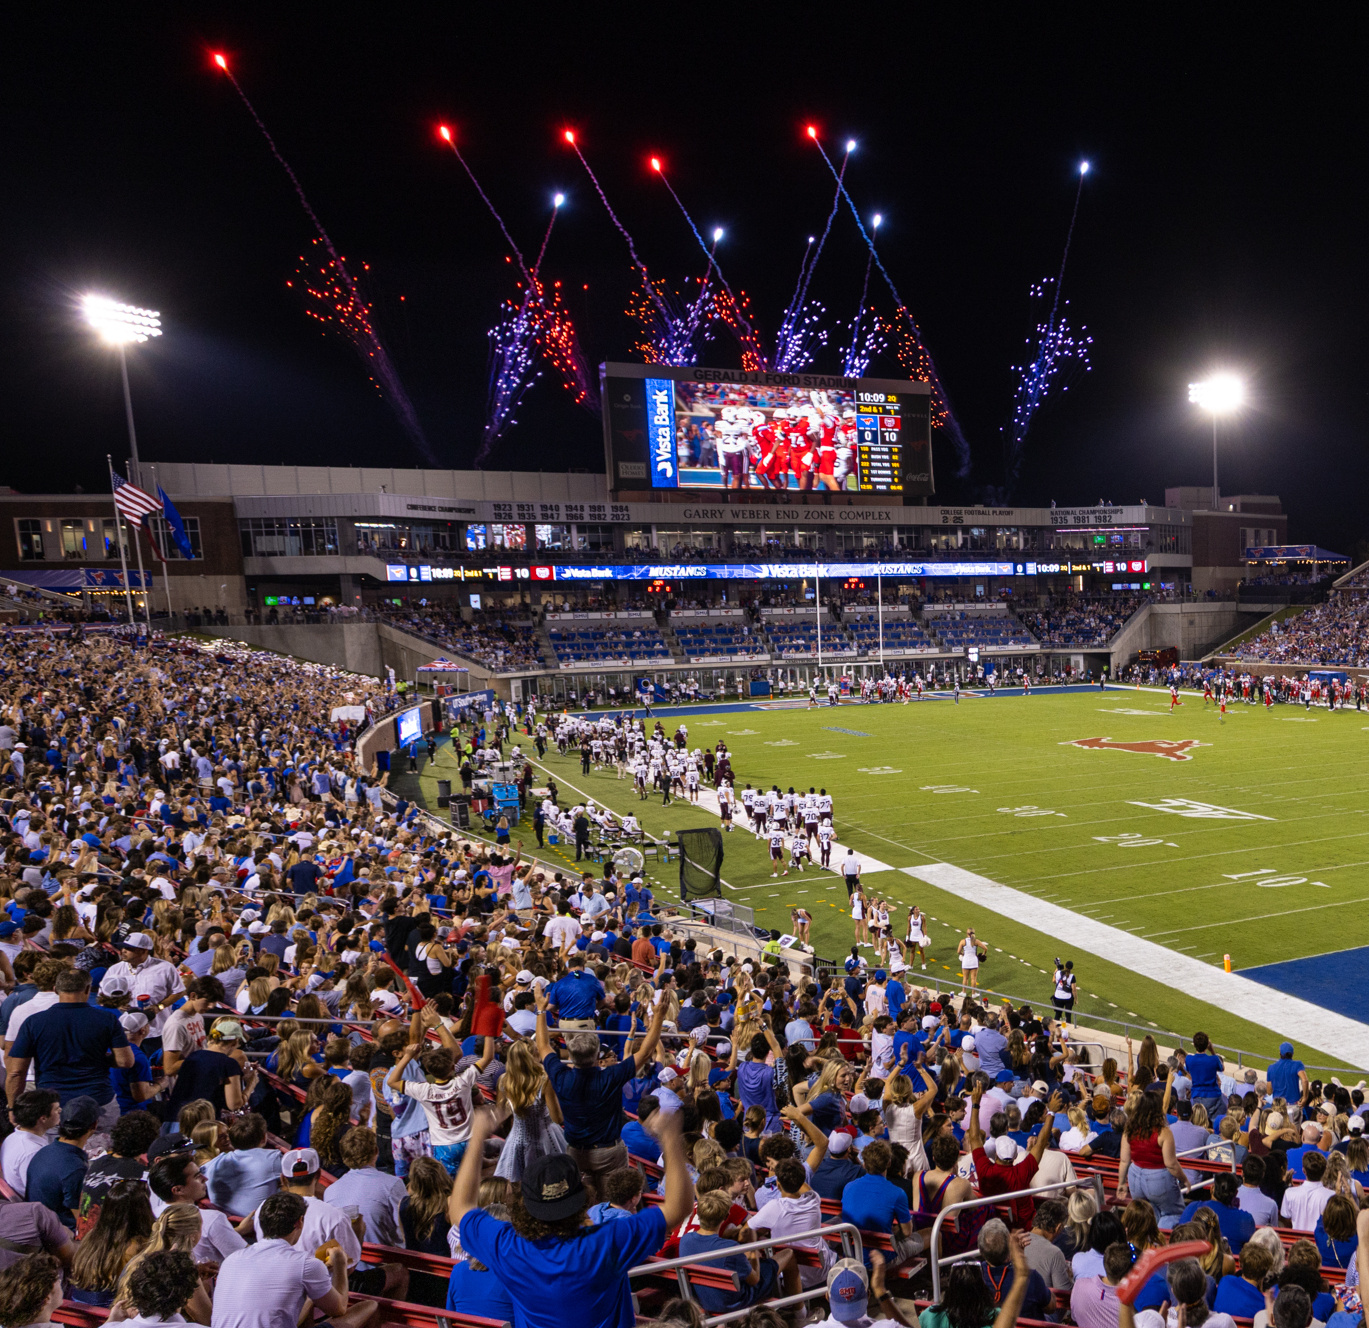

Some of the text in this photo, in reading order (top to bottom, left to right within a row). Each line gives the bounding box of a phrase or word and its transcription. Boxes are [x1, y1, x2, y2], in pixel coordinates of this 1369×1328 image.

[693, 369, 858, 389] GERALD J. FORD STADIUM
[859, 392, 885, 402] 10:09
[652, 389, 671, 461] Vista Bank
[864, 431, 871, 440] 0
[884, 432, 897, 442] 10
[406, 503, 476, 515] CONFERENCE CHAMPIONSHIPS
[493, 503, 629, 513] 1923 1931 1940 1948 1981 1984
[494, 512, 513, 520] 1926
[517, 512, 536, 520] 1935
[540, 512, 560, 520] 1947
[611, 513, 631, 521] 2023
[684, 509, 891, 520] GARRY WEBER END ZONE COMPLEX
[1051, 515, 1112, 524] 1935 1981 1982
[648, 566, 707, 577] MUSTANGS
[768, 564, 829, 578] Vista Bank
[873, 565, 923, 574] MUSTANGS
[1017, 564, 1023, 572] 0
[1037, 564, 1059, 572] 10:09
[1116, 563, 1126, 571] 10
[431, 568, 454, 579] 10:09
[514, 568, 529, 578] 10
[774, 804, 785, 812] 75
[820, 801, 830, 809] 77
[996, 805, 1057, 817] 30
[793, 841, 804, 850] 25
[1092, 833, 1164, 848] 20
[1221, 868, 1308, 887] 10
[432, 1096, 468, 1129] 19
[838, 1286, 856, 1295] SMU
